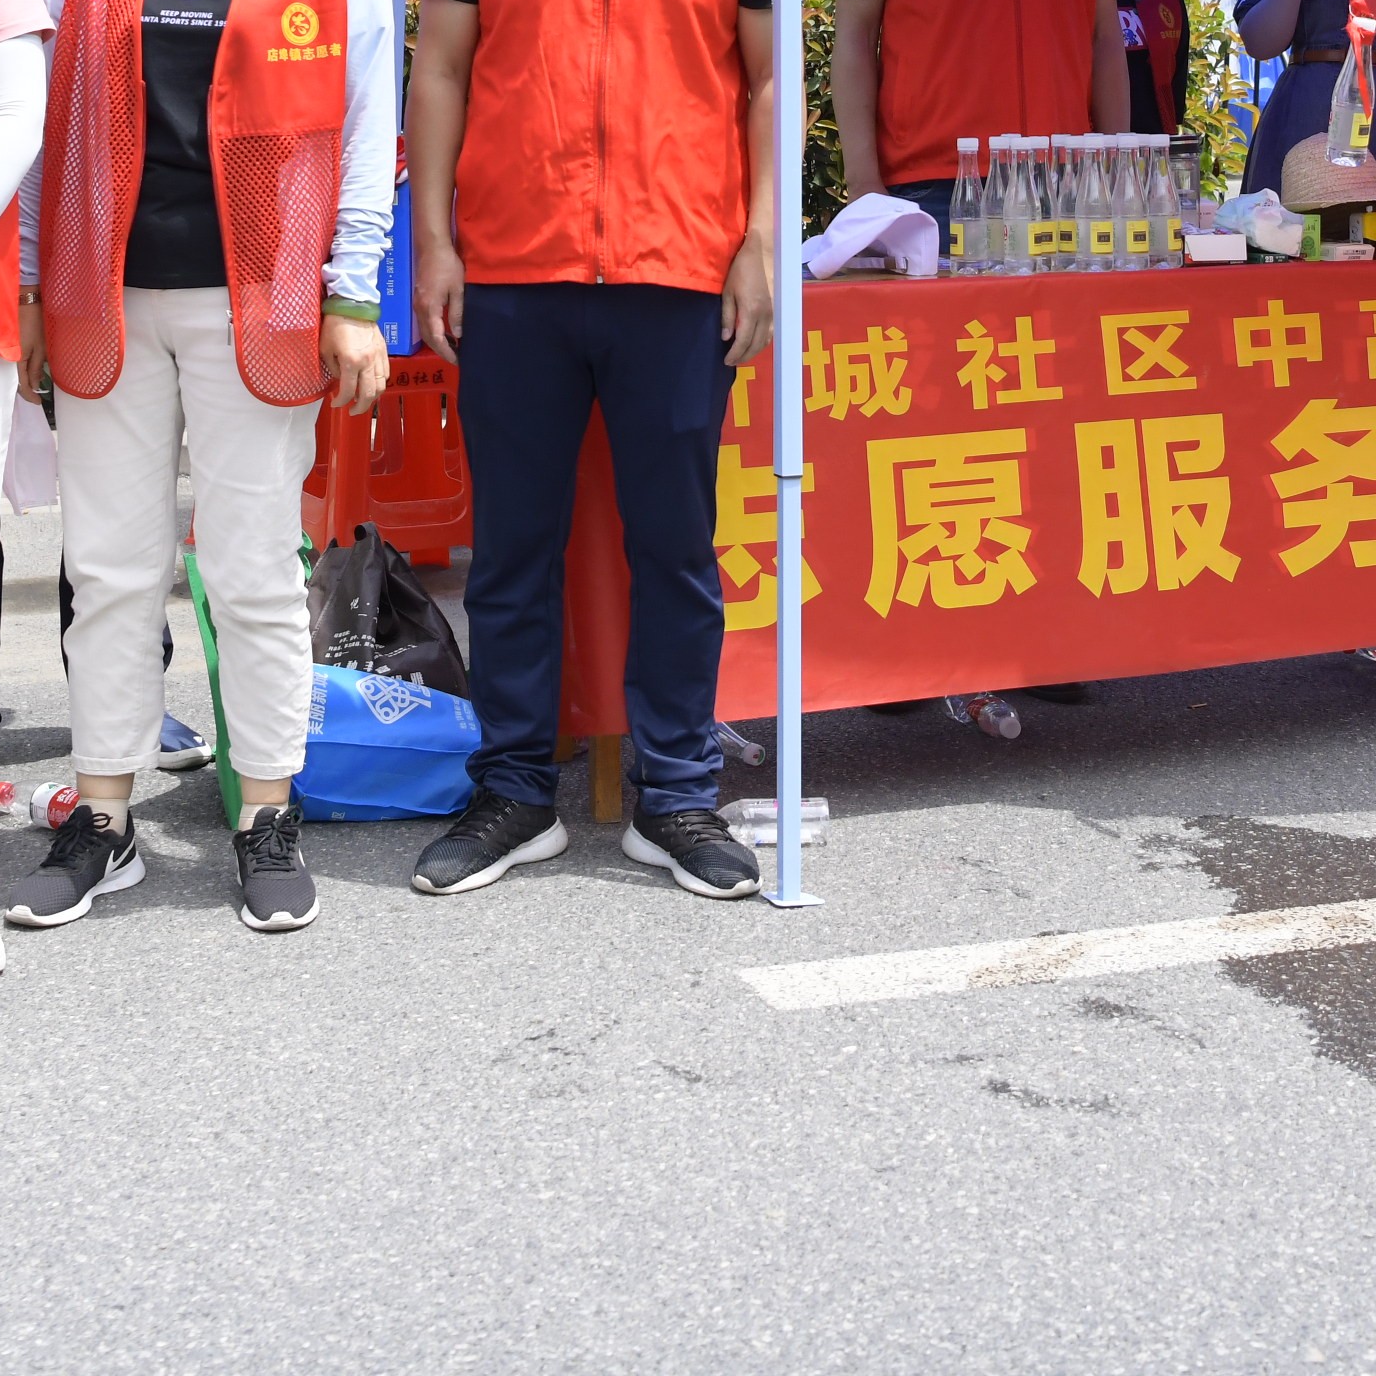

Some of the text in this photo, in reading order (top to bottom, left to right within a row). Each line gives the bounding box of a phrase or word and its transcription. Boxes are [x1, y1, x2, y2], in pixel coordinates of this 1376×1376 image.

[180, 11, 214, 19] MOVING
[160, 17, 190, 26] SPORTS
[190, 19, 213, 27] SINCE
[386, 369, 445, 388] 园社区
